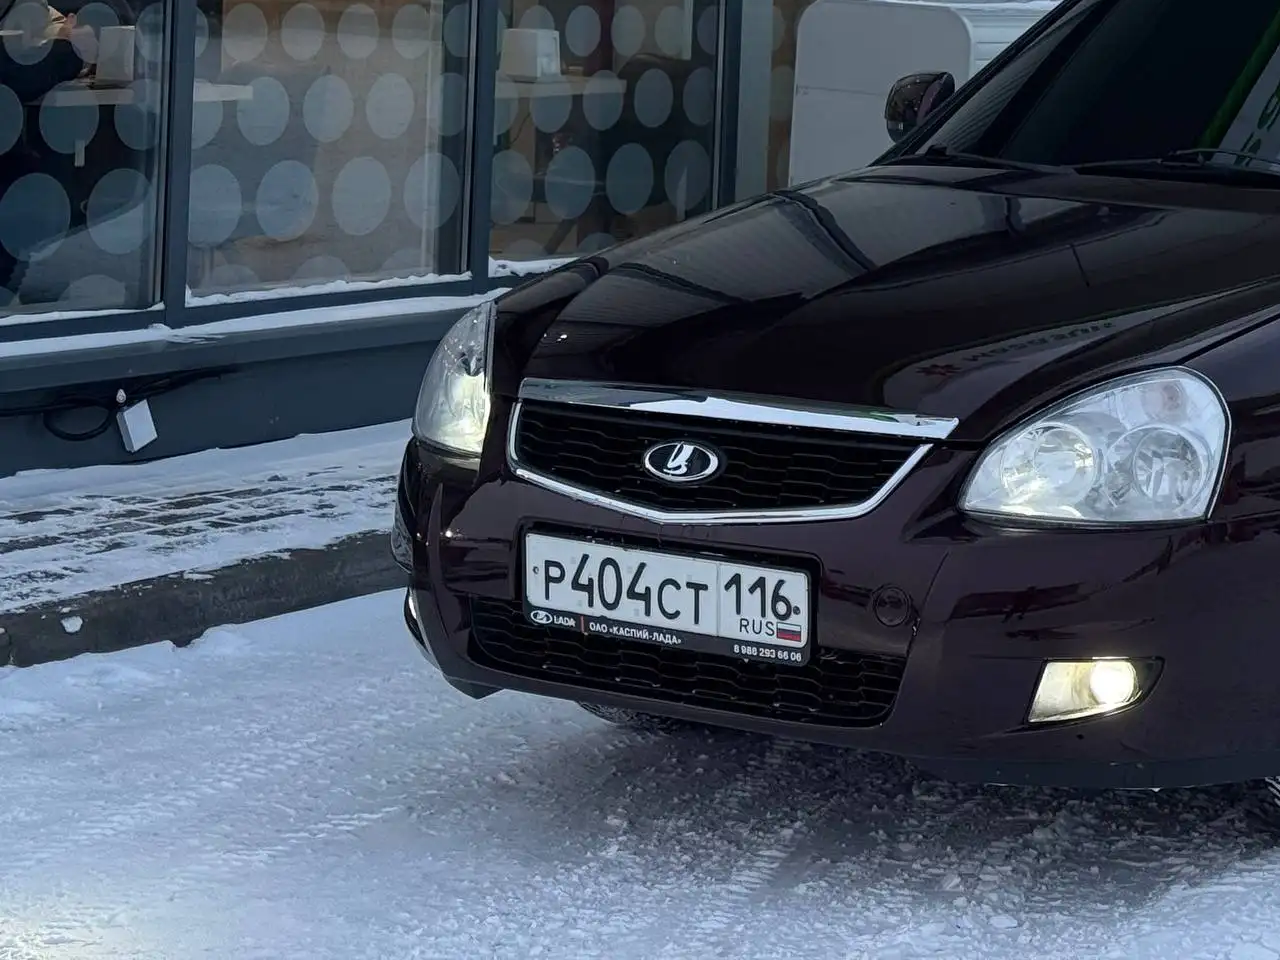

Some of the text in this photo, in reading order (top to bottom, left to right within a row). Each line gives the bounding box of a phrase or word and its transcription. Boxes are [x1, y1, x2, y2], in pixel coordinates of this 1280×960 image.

[543, 553, 792, 625] Р404СТ 116
[553, 615, 576, 627] LADA
[739, 618, 775, 637] RUS
[589, 621, 681, 645] ОАО «КАСПИЙ-ЛАДА»
[733, 644, 740, 653] 8
